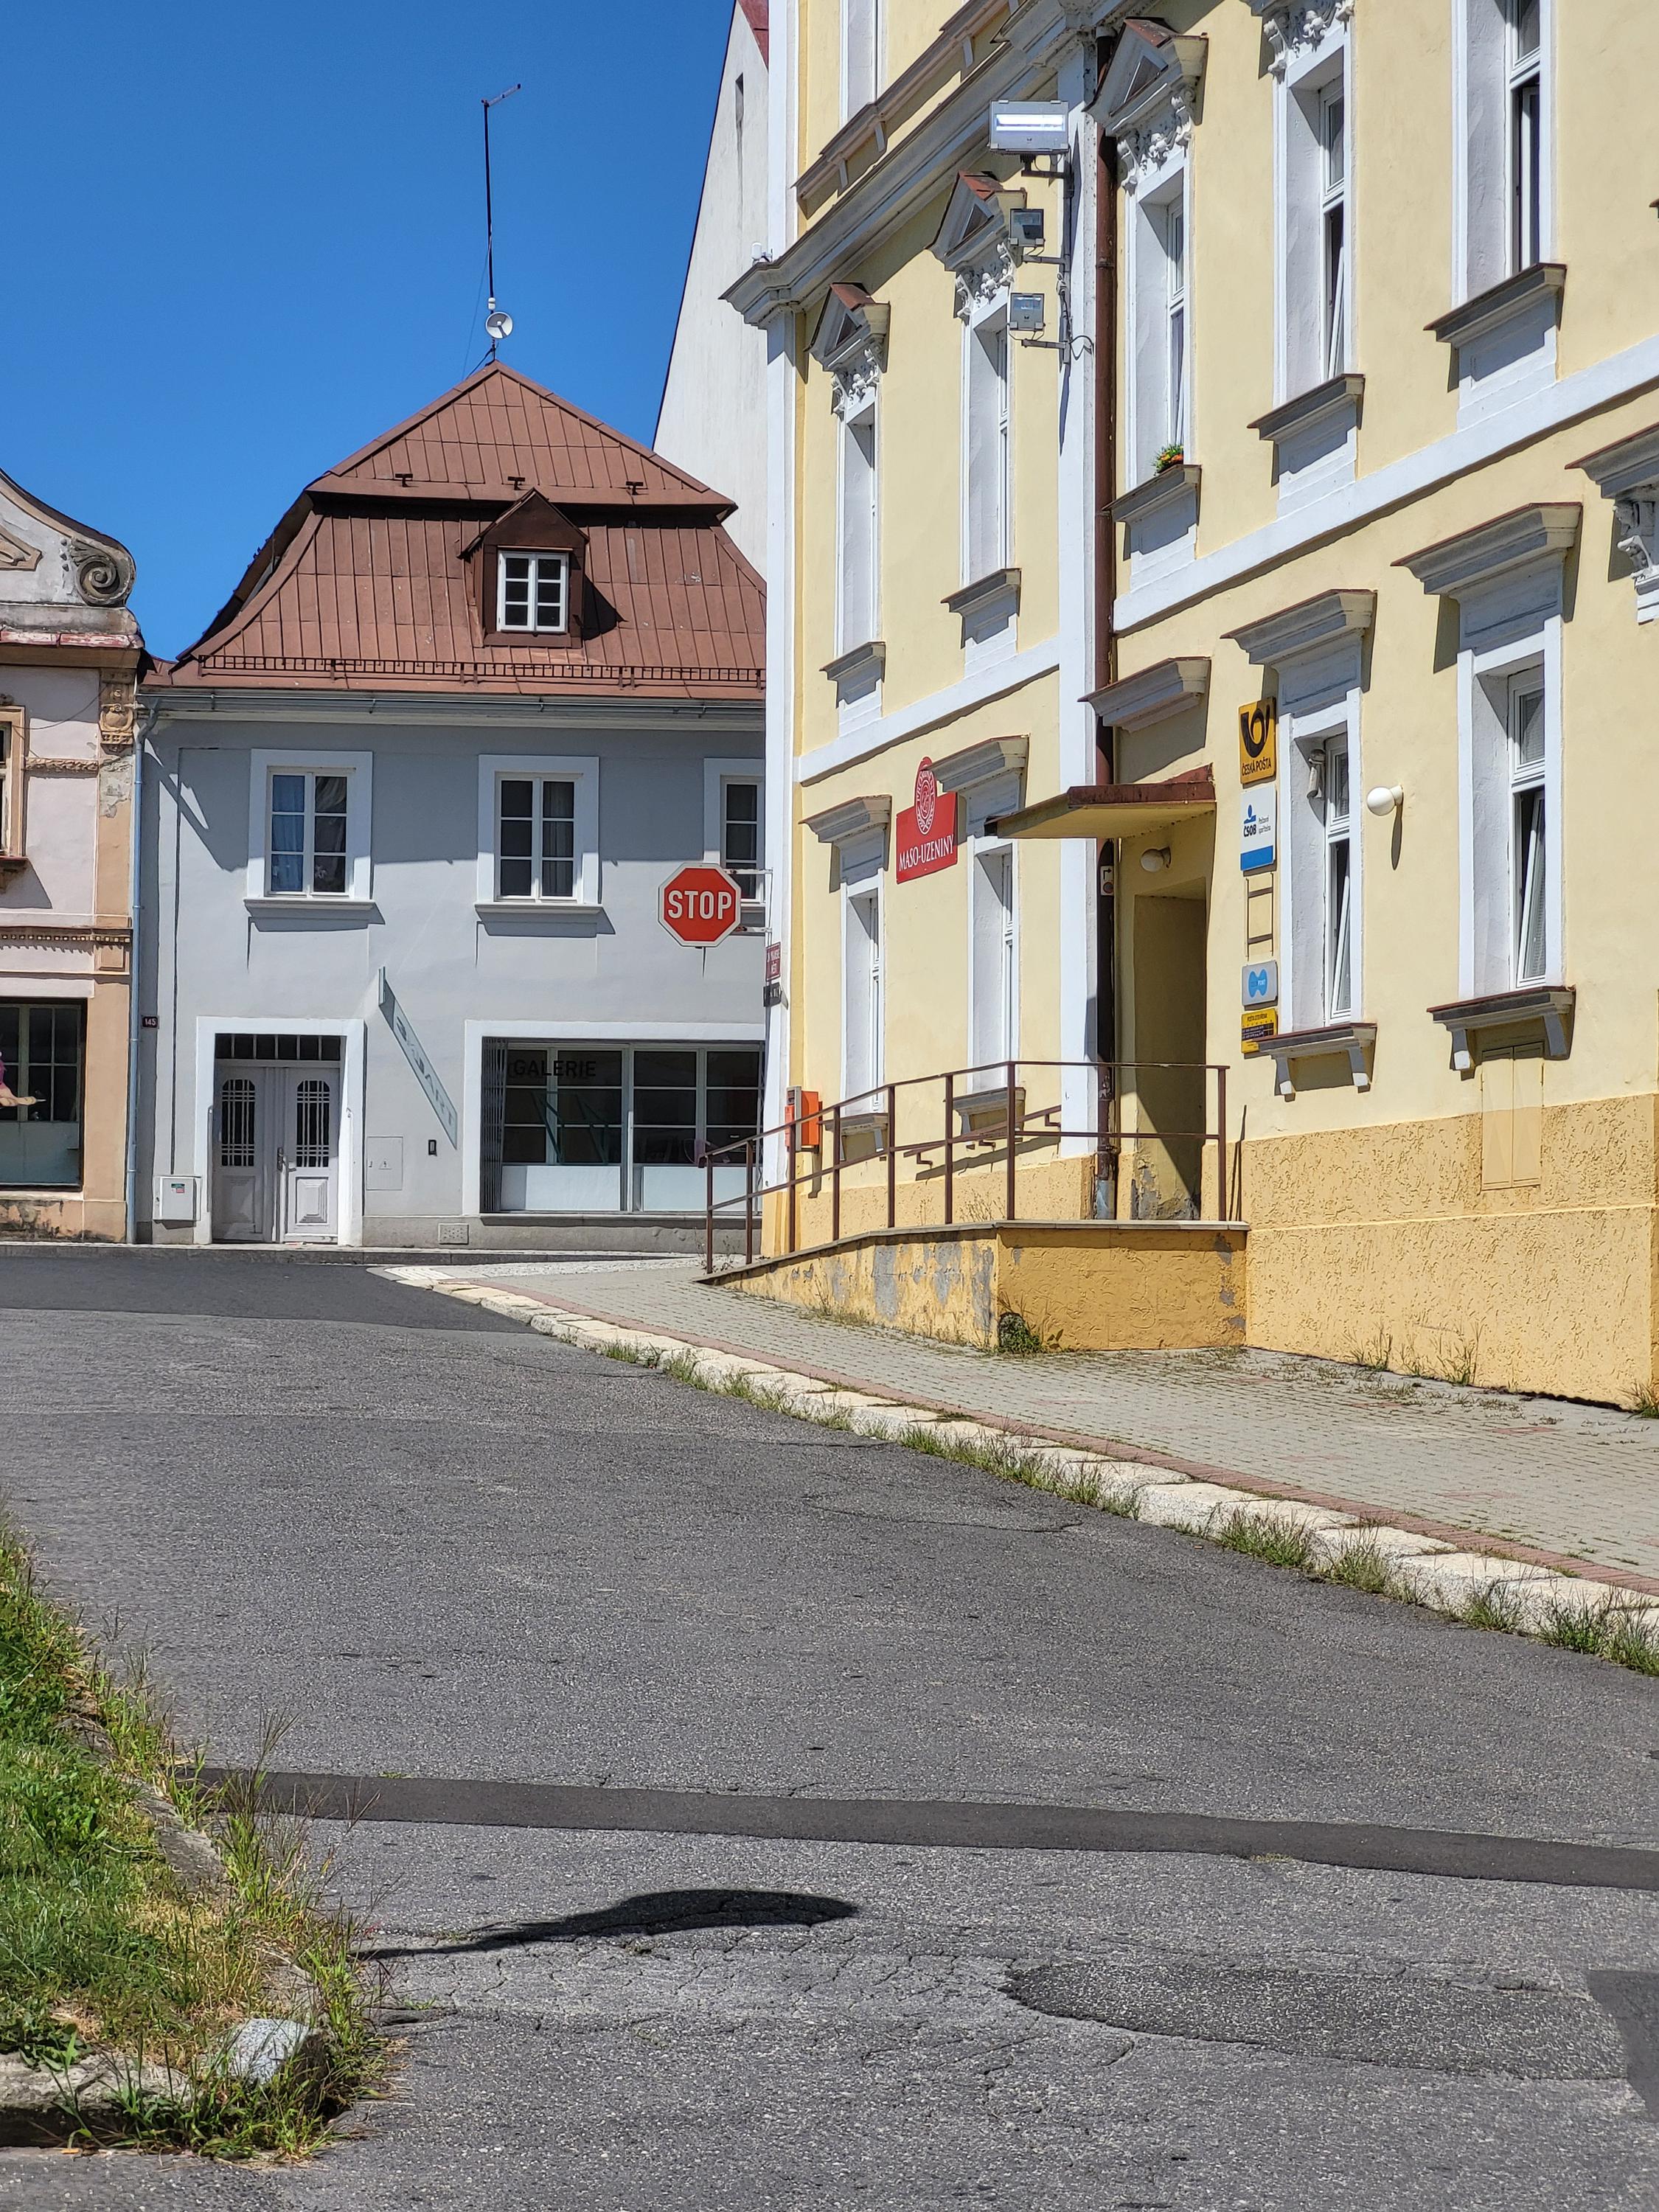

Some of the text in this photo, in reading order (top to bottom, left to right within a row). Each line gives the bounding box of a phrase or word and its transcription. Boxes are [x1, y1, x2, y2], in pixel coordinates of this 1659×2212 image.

[1242, 757, 1271, 776] ČESKÁ POŠTA
[1244, 824, 1256, 837] ČSOB
[899, 834, 953, 872] MASO-UZENINY
[668, 890, 731, 919] STOP
[145, 1018, 156, 1026] 145
[514, 1060, 597, 1077] GALERIE
